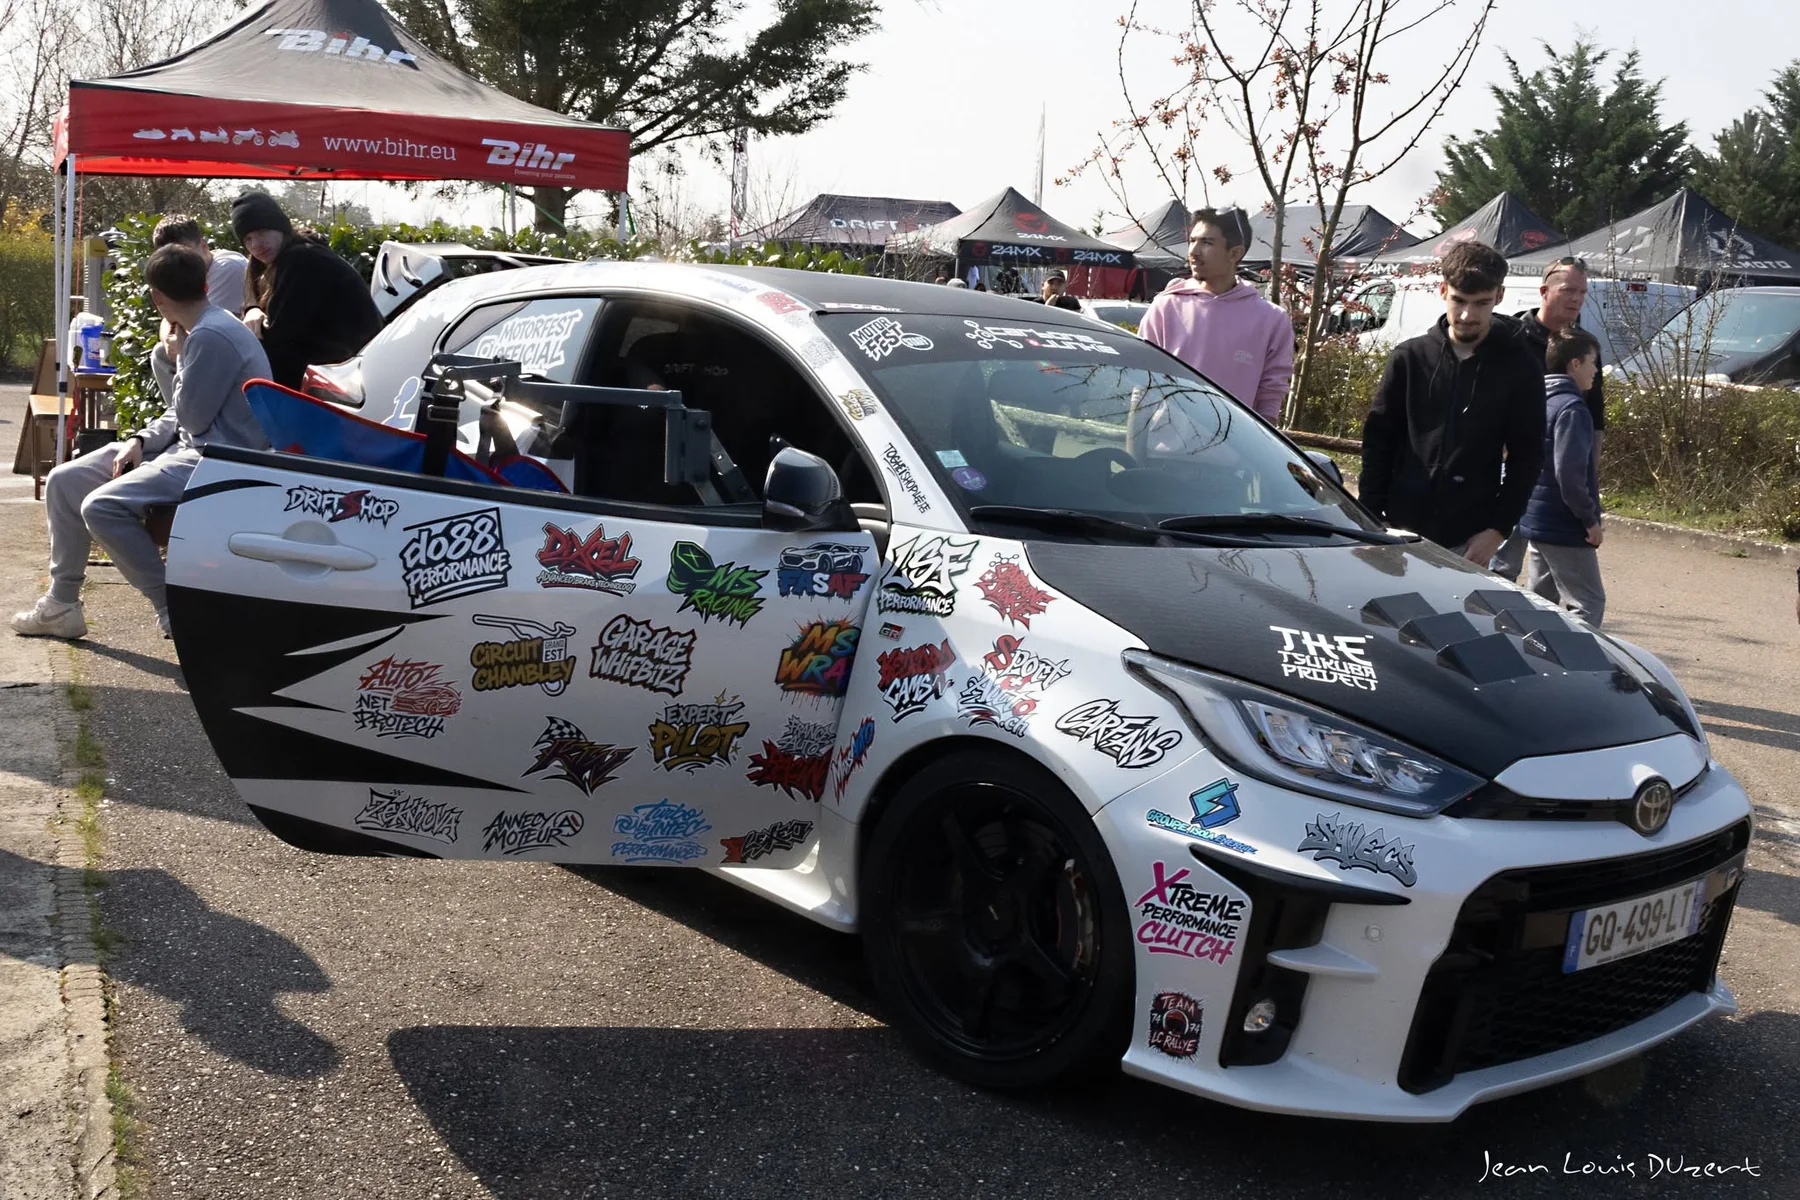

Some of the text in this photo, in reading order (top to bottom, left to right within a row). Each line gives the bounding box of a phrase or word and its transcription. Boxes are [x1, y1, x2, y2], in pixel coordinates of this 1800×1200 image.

[264, 28, 417, 65] Bihr
[323, 137, 456, 161] www.bihr.eu
[481, 138, 576, 170] Bihr
[830, 218, 899, 231] DRIFT
[1016, 232, 1067, 242] 24MX
[991, 244, 1042, 257] 24MX
[1073, 250, 1122, 264] 24MX
[500, 309, 583, 343] MOTORFEST
[850, 316, 892, 347] MOTOR
[860, 320, 902, 362] FEST
[400, 514, 500, 570] do88
[403, 550, 512, 597] PERFORMANCE
[536, 569, 637, 595] ADVANCED BRAKE TECHNOLOGY
[705, 561, 770, 598] MS
[677, 588, 766, 630] RACING
[877, 591, 956, 618] PERFORMANCE
[544, 639, 565, 651] GRAND
[600, 614, 697, 664] GARAGE
[798, 622, 862, 657] MS
[1269, 625, 1373, 667] THE
[544, 648, 563, 662] EST
[1277, 650, 1377, 679] TSUKUBA
[472, 656, 577, 692] CHAMBLEY
[1281, 663, 1379, 691] PROJECT
[356, 693, 392, 711] NET
[882, 673, 937, 708] CAMS
[352, 708, 445, 739] PROTECH
[664, 703, 744, 725] EXPERT
[784, 715, 836, 742] FRANCE
[482, 809, 557, 836] ANNECY
[1146, 808, 1190, 833] GROUPE
[482, 828, 570, 853] MOTEUR
[611, 842, 709, 860] PERFORMANCE
[1133, 861, 1247, 922] XTREME
[1141, 902, 1238, 939] PERFORMANCE
[1136, 920, 1235, 965] CLUTCH
[1151, 1012, 1162, 1024] 74
[1160, 995, 1196, 1017] TEAM
[1151, 1031, 1197, 1052] LC RALLYE
[1189, 1022, 1200, 1034] 74
